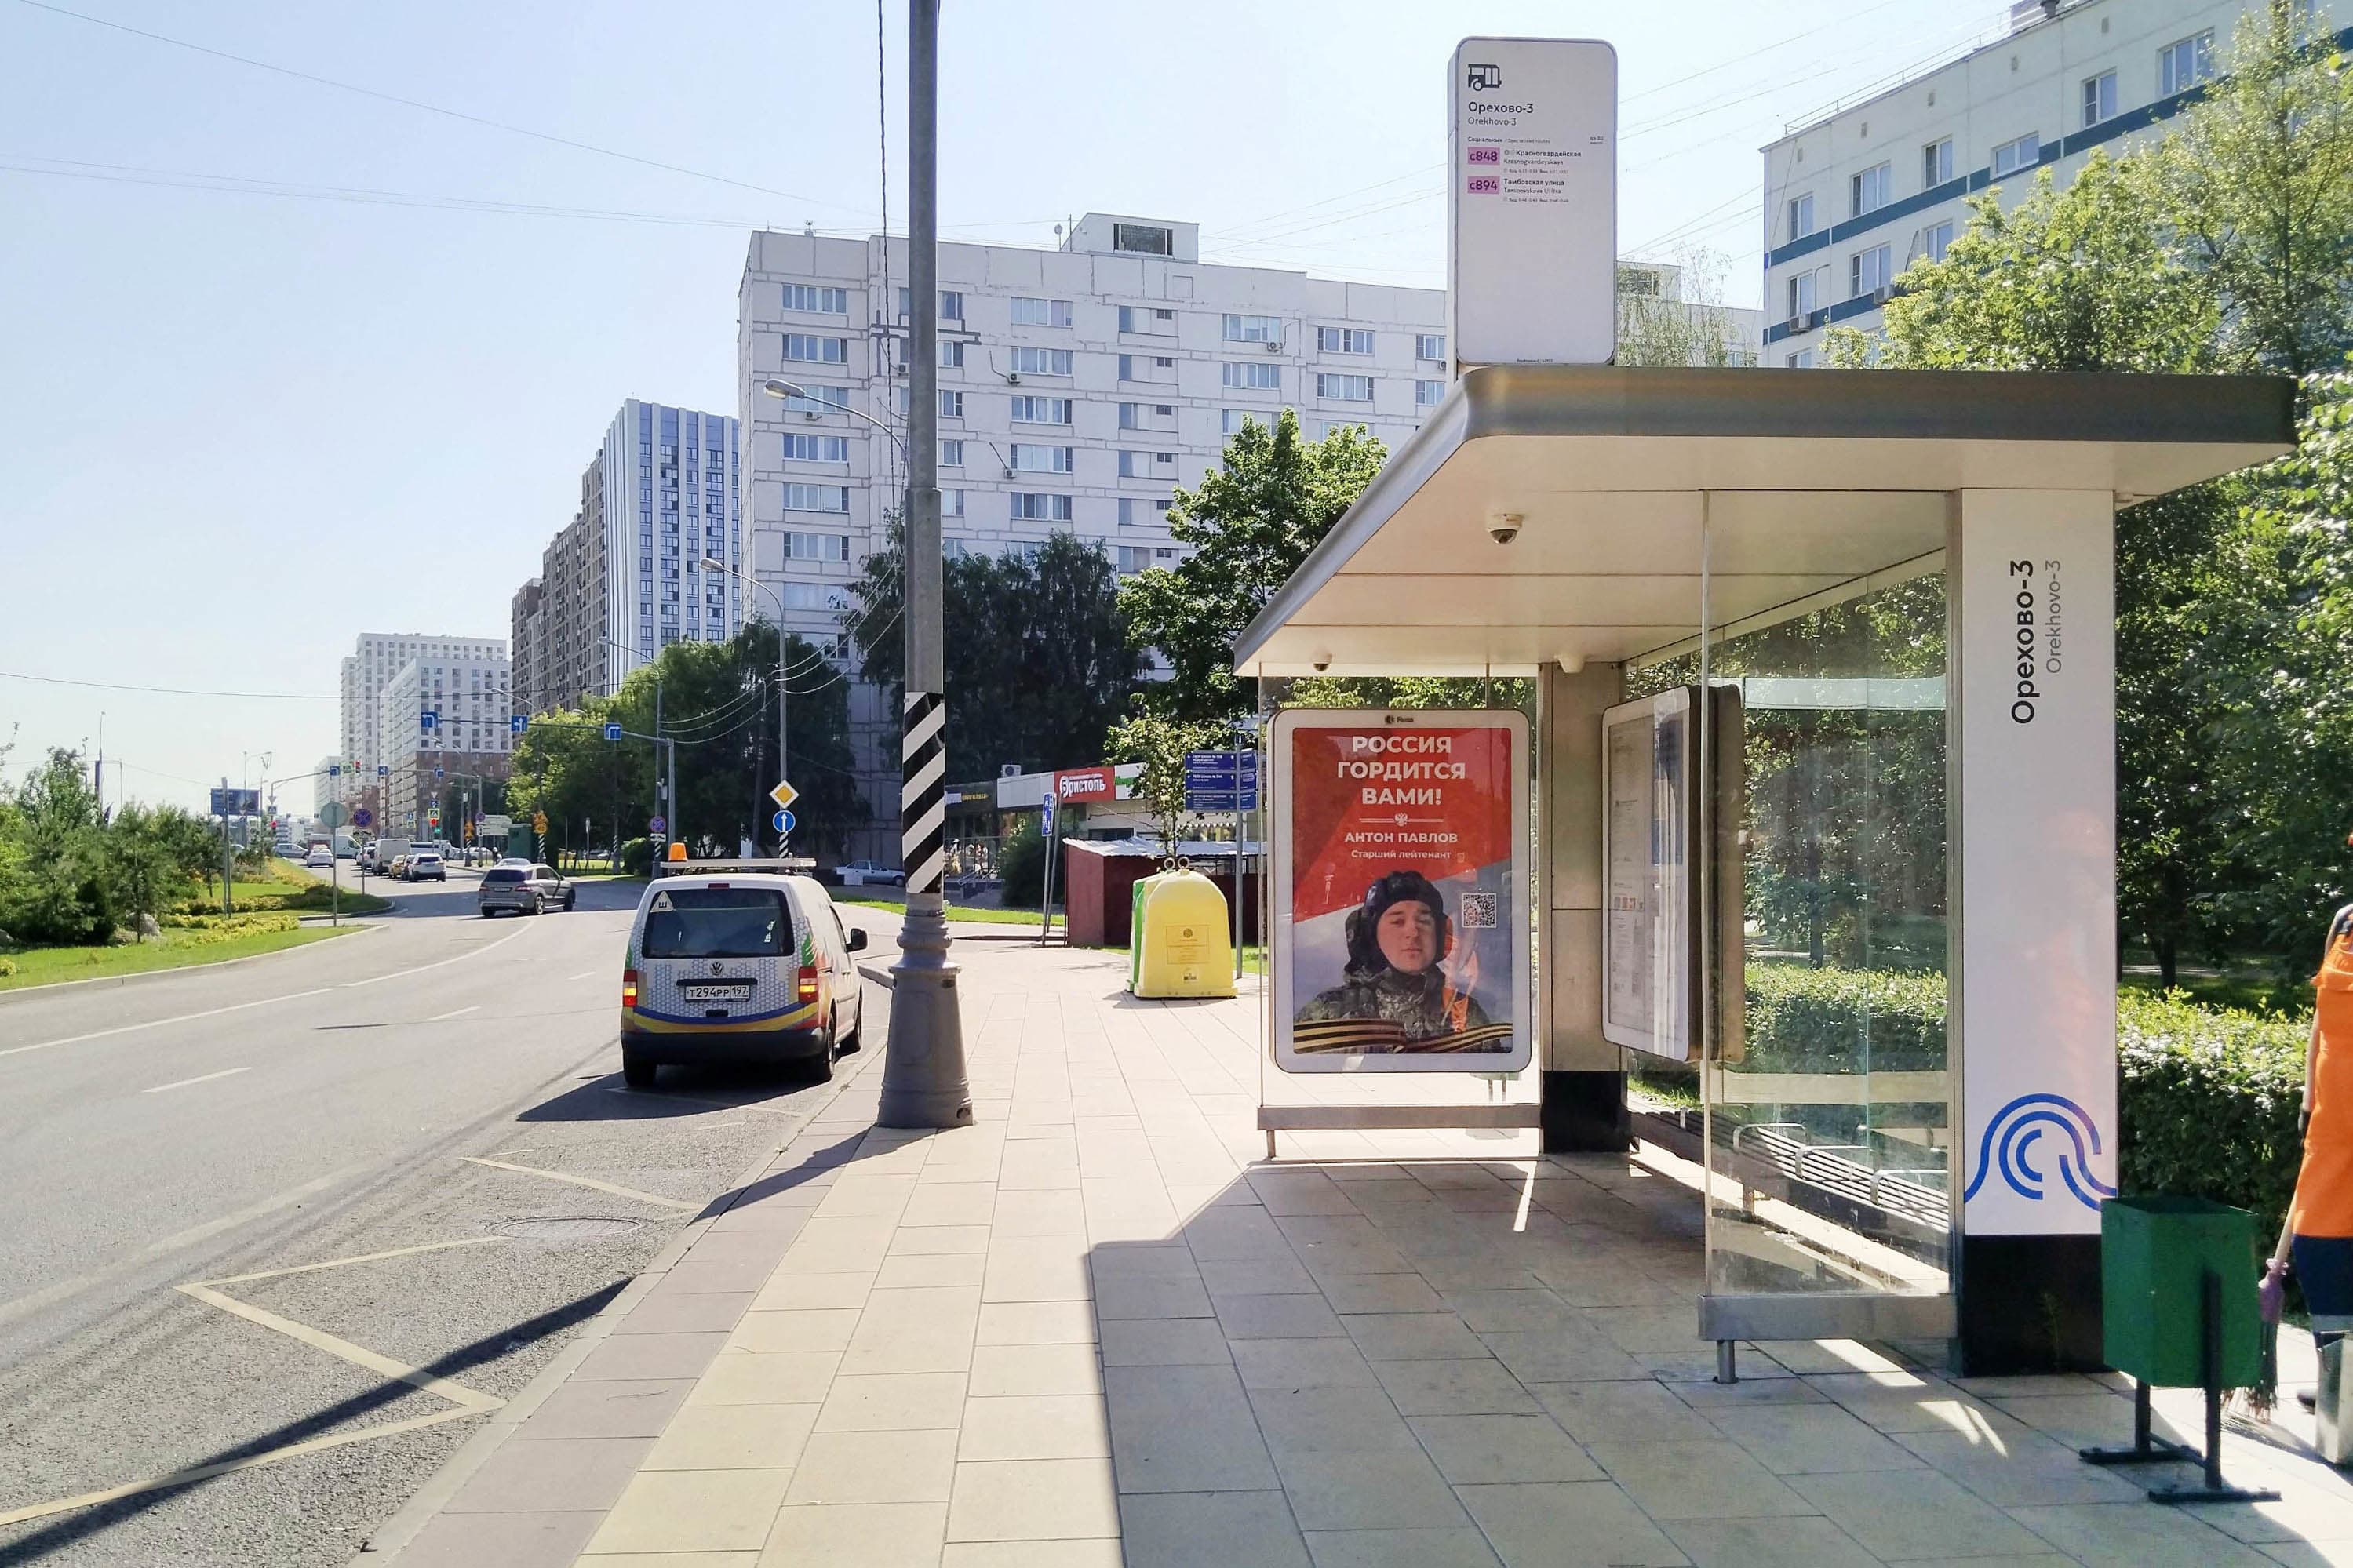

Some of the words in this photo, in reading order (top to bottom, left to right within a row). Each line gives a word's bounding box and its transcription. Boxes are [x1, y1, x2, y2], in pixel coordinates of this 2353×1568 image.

[1468, 101, 1534, 115] Орехово-3
[1467, 117, 1517, 126] Orekhovo-3
[2045, 559, 2062, 674] Orekhovo-3
[2010, 559, 2040, 724] Орехово-3
[1352, 736, 1452, 754] РОССИЯ
[1337, 762, 1466, 781] ГОРДИТСЯ
[1059, 775, 1107, 798] Бристоль
[1362, 788, 1442, 806] ВАМИ!
[1344, 832, 1394, 843] АНТОН
[1398, 832, 1458, 843] ПАВЛОВ
[1351, 849, 1397, 860] Старший
[1399, 849, 1452, 859] лейтенант
